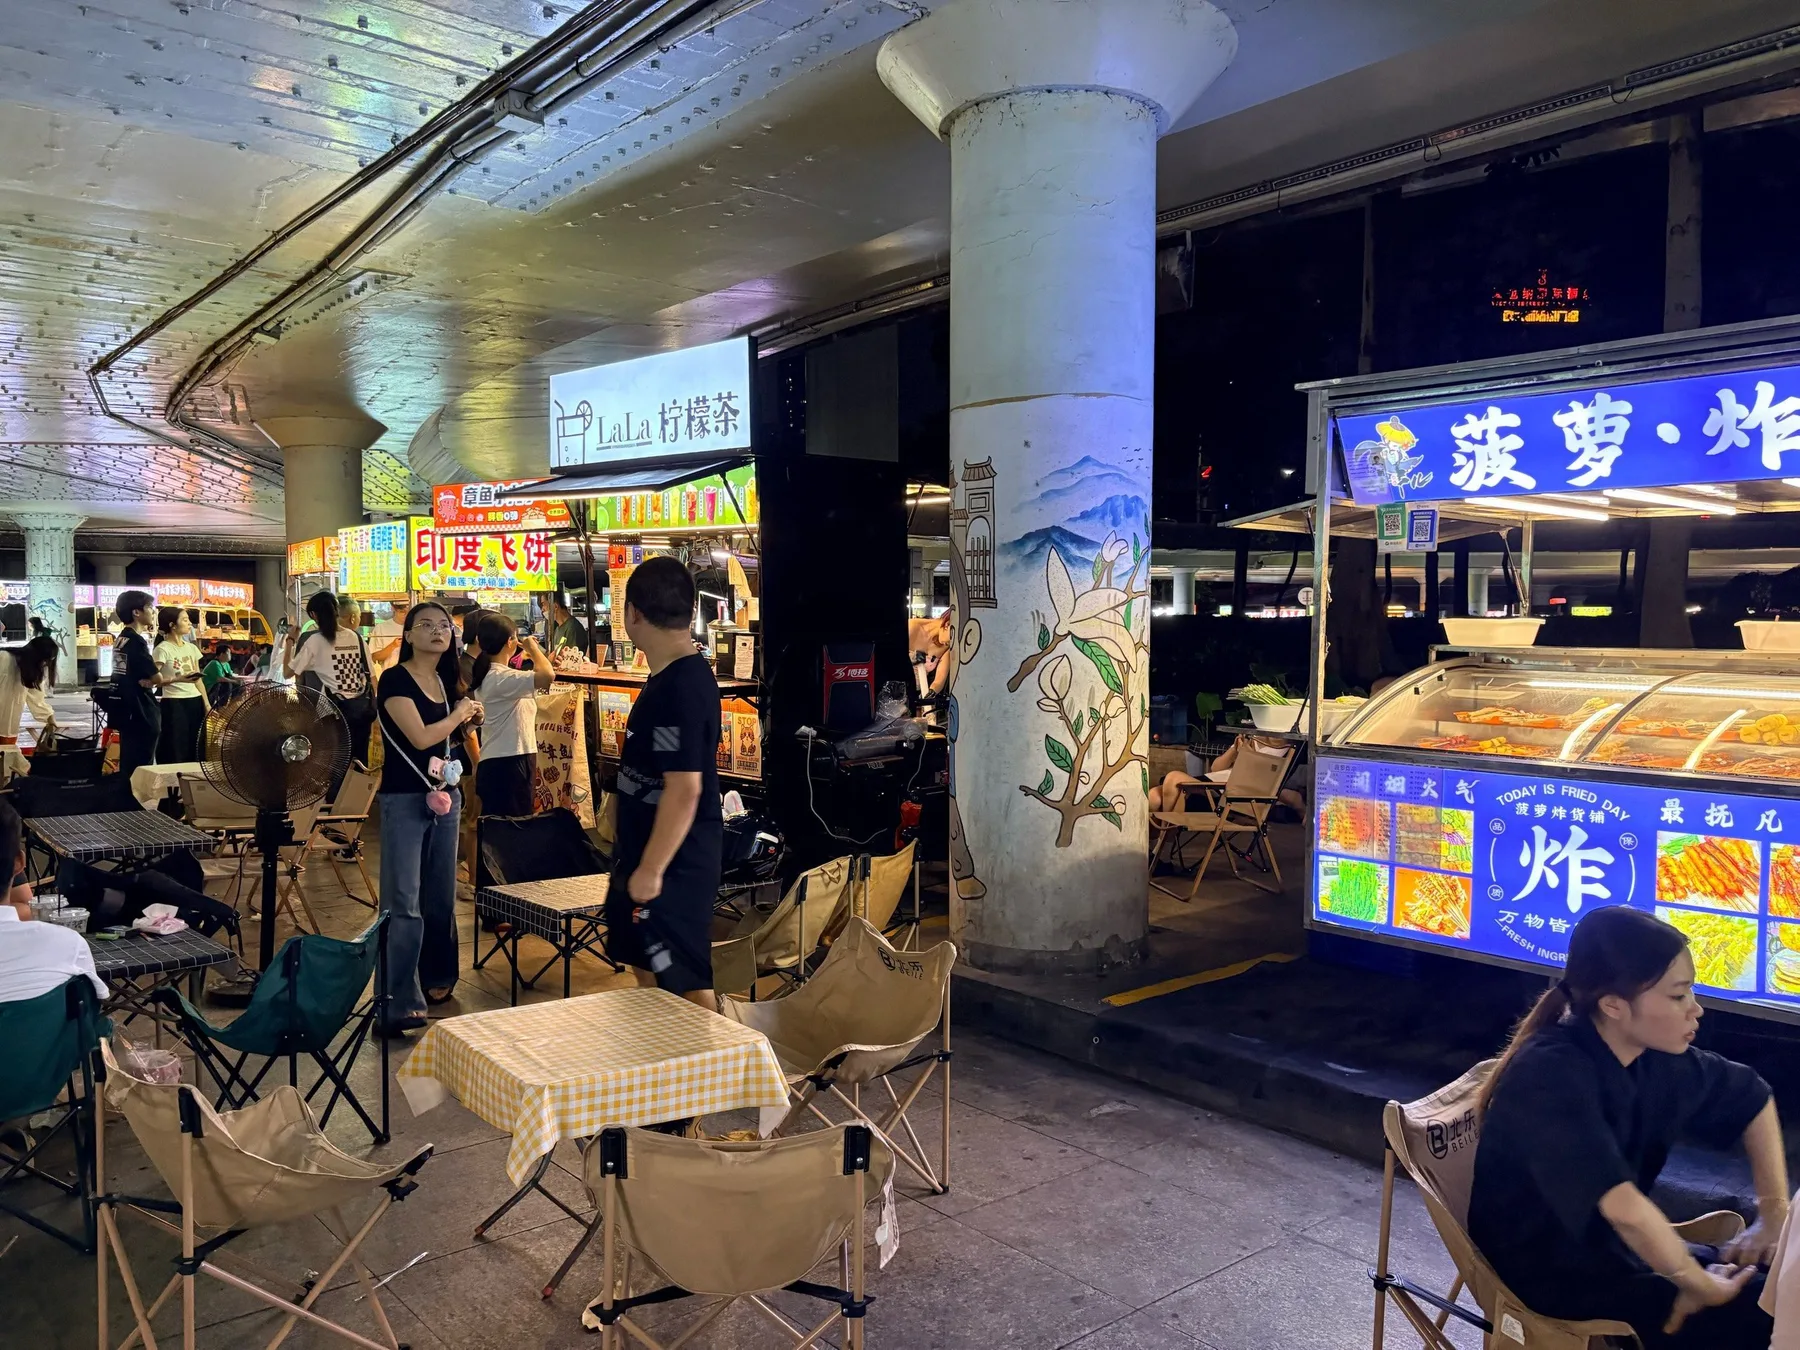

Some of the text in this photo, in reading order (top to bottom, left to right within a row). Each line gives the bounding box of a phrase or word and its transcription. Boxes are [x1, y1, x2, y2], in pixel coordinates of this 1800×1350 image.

[597, 391, 740, 445] LaLa 柠檬茶
[416, 529, 553, 574] 印度飞饼
[737, 716, 757, 726] STOP
[1322, 770, 1480, 804] 人间烟火气
[1496, 784, 1631, 822] TODAY IS FRIED DAY
[1515, 802, 1605, 824] 菠萝炸货铺
[1660, 797, 1783, 833] 最抚凡
[1511, 824, 1615, 914] 炸
[1498, 909, 1574, 934] 万物皆
[1501, 924, 1535, 953] FRESH
